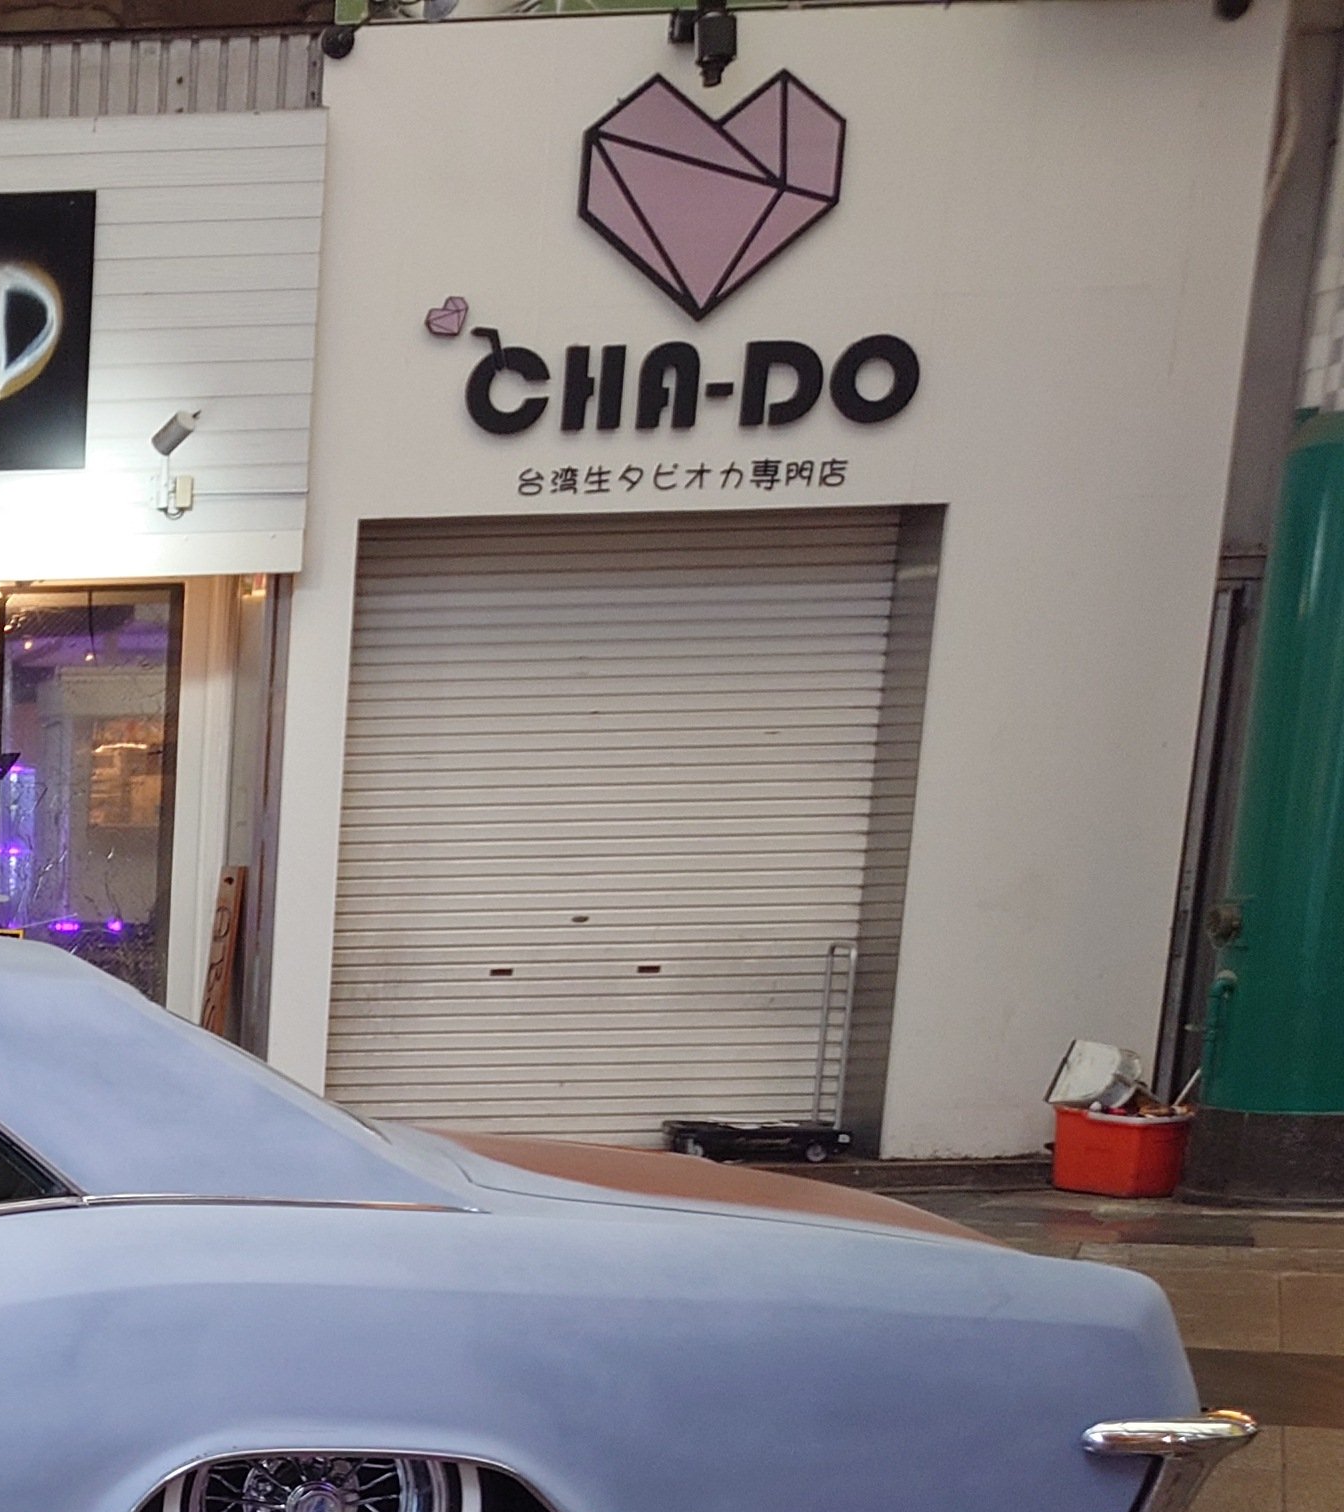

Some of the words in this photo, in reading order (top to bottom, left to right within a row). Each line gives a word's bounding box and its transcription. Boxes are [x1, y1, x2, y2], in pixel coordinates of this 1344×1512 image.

[464, 327, 920, 436] CHA-DO
[517, 459, 849, 496] 台湾生タピオカ専門店
